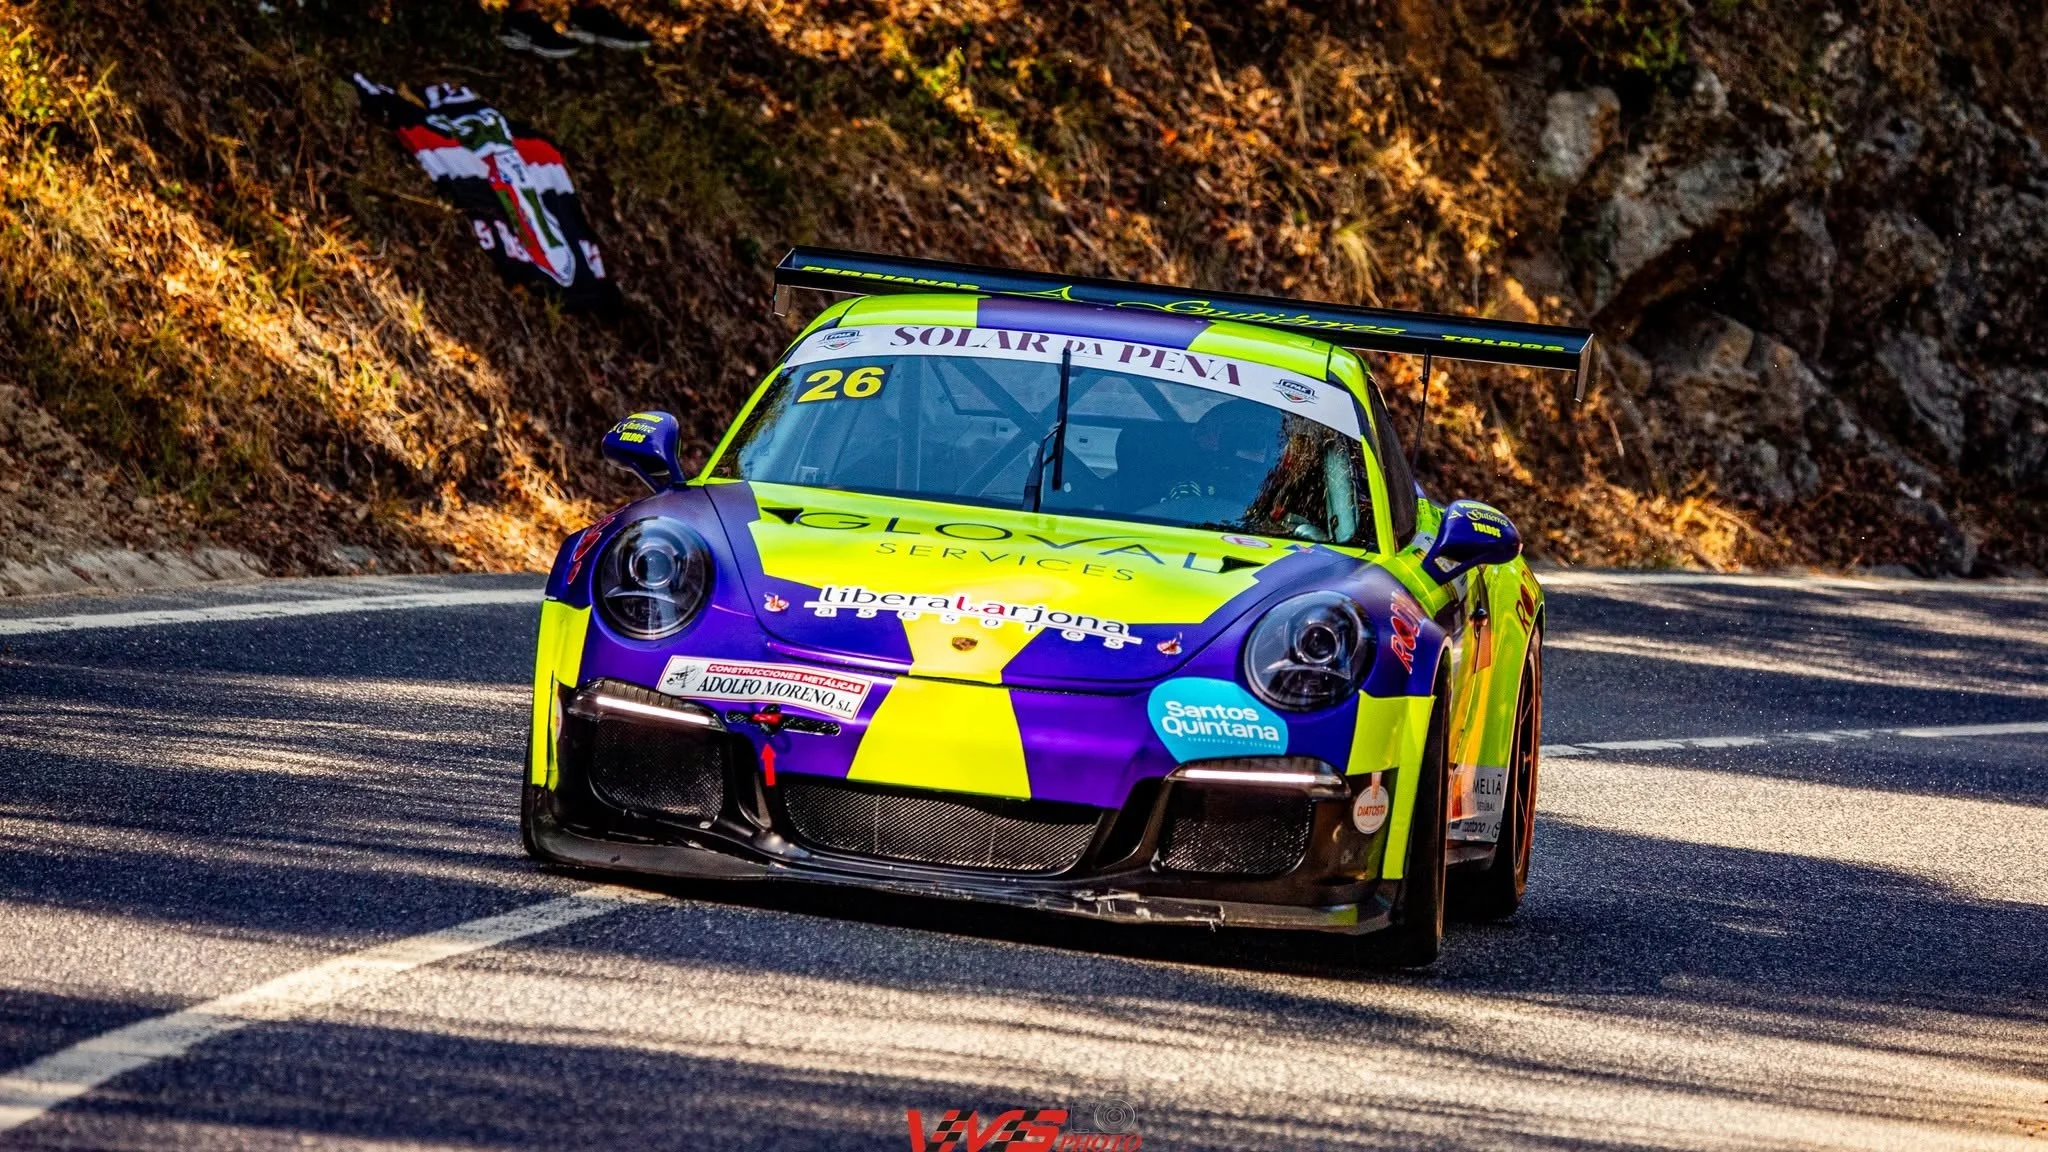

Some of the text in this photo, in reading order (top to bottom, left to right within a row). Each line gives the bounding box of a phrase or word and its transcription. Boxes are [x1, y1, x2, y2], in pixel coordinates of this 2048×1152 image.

[802, 265, 980, 290] PERSIANAS
[1441, 334, 1565, 352] TOLDOS
[890, 326, 1241, 387] SOLAR DA PENA
[797, 366, 886, 404] 26
[796, 511, 1225, 575] GLOVAL
[1472, 521, 1502, 539] TOLDOS
[875, 541, 1136, 582] SERVICES
[697, 675, 761, 695] ADOLFO
[708, 664, 862, 694] CONSTRUCCIONES METÁLICAS
[1165, 700, 1260, 722] Santos
[1161, 716, 1280, 742] Quintana
